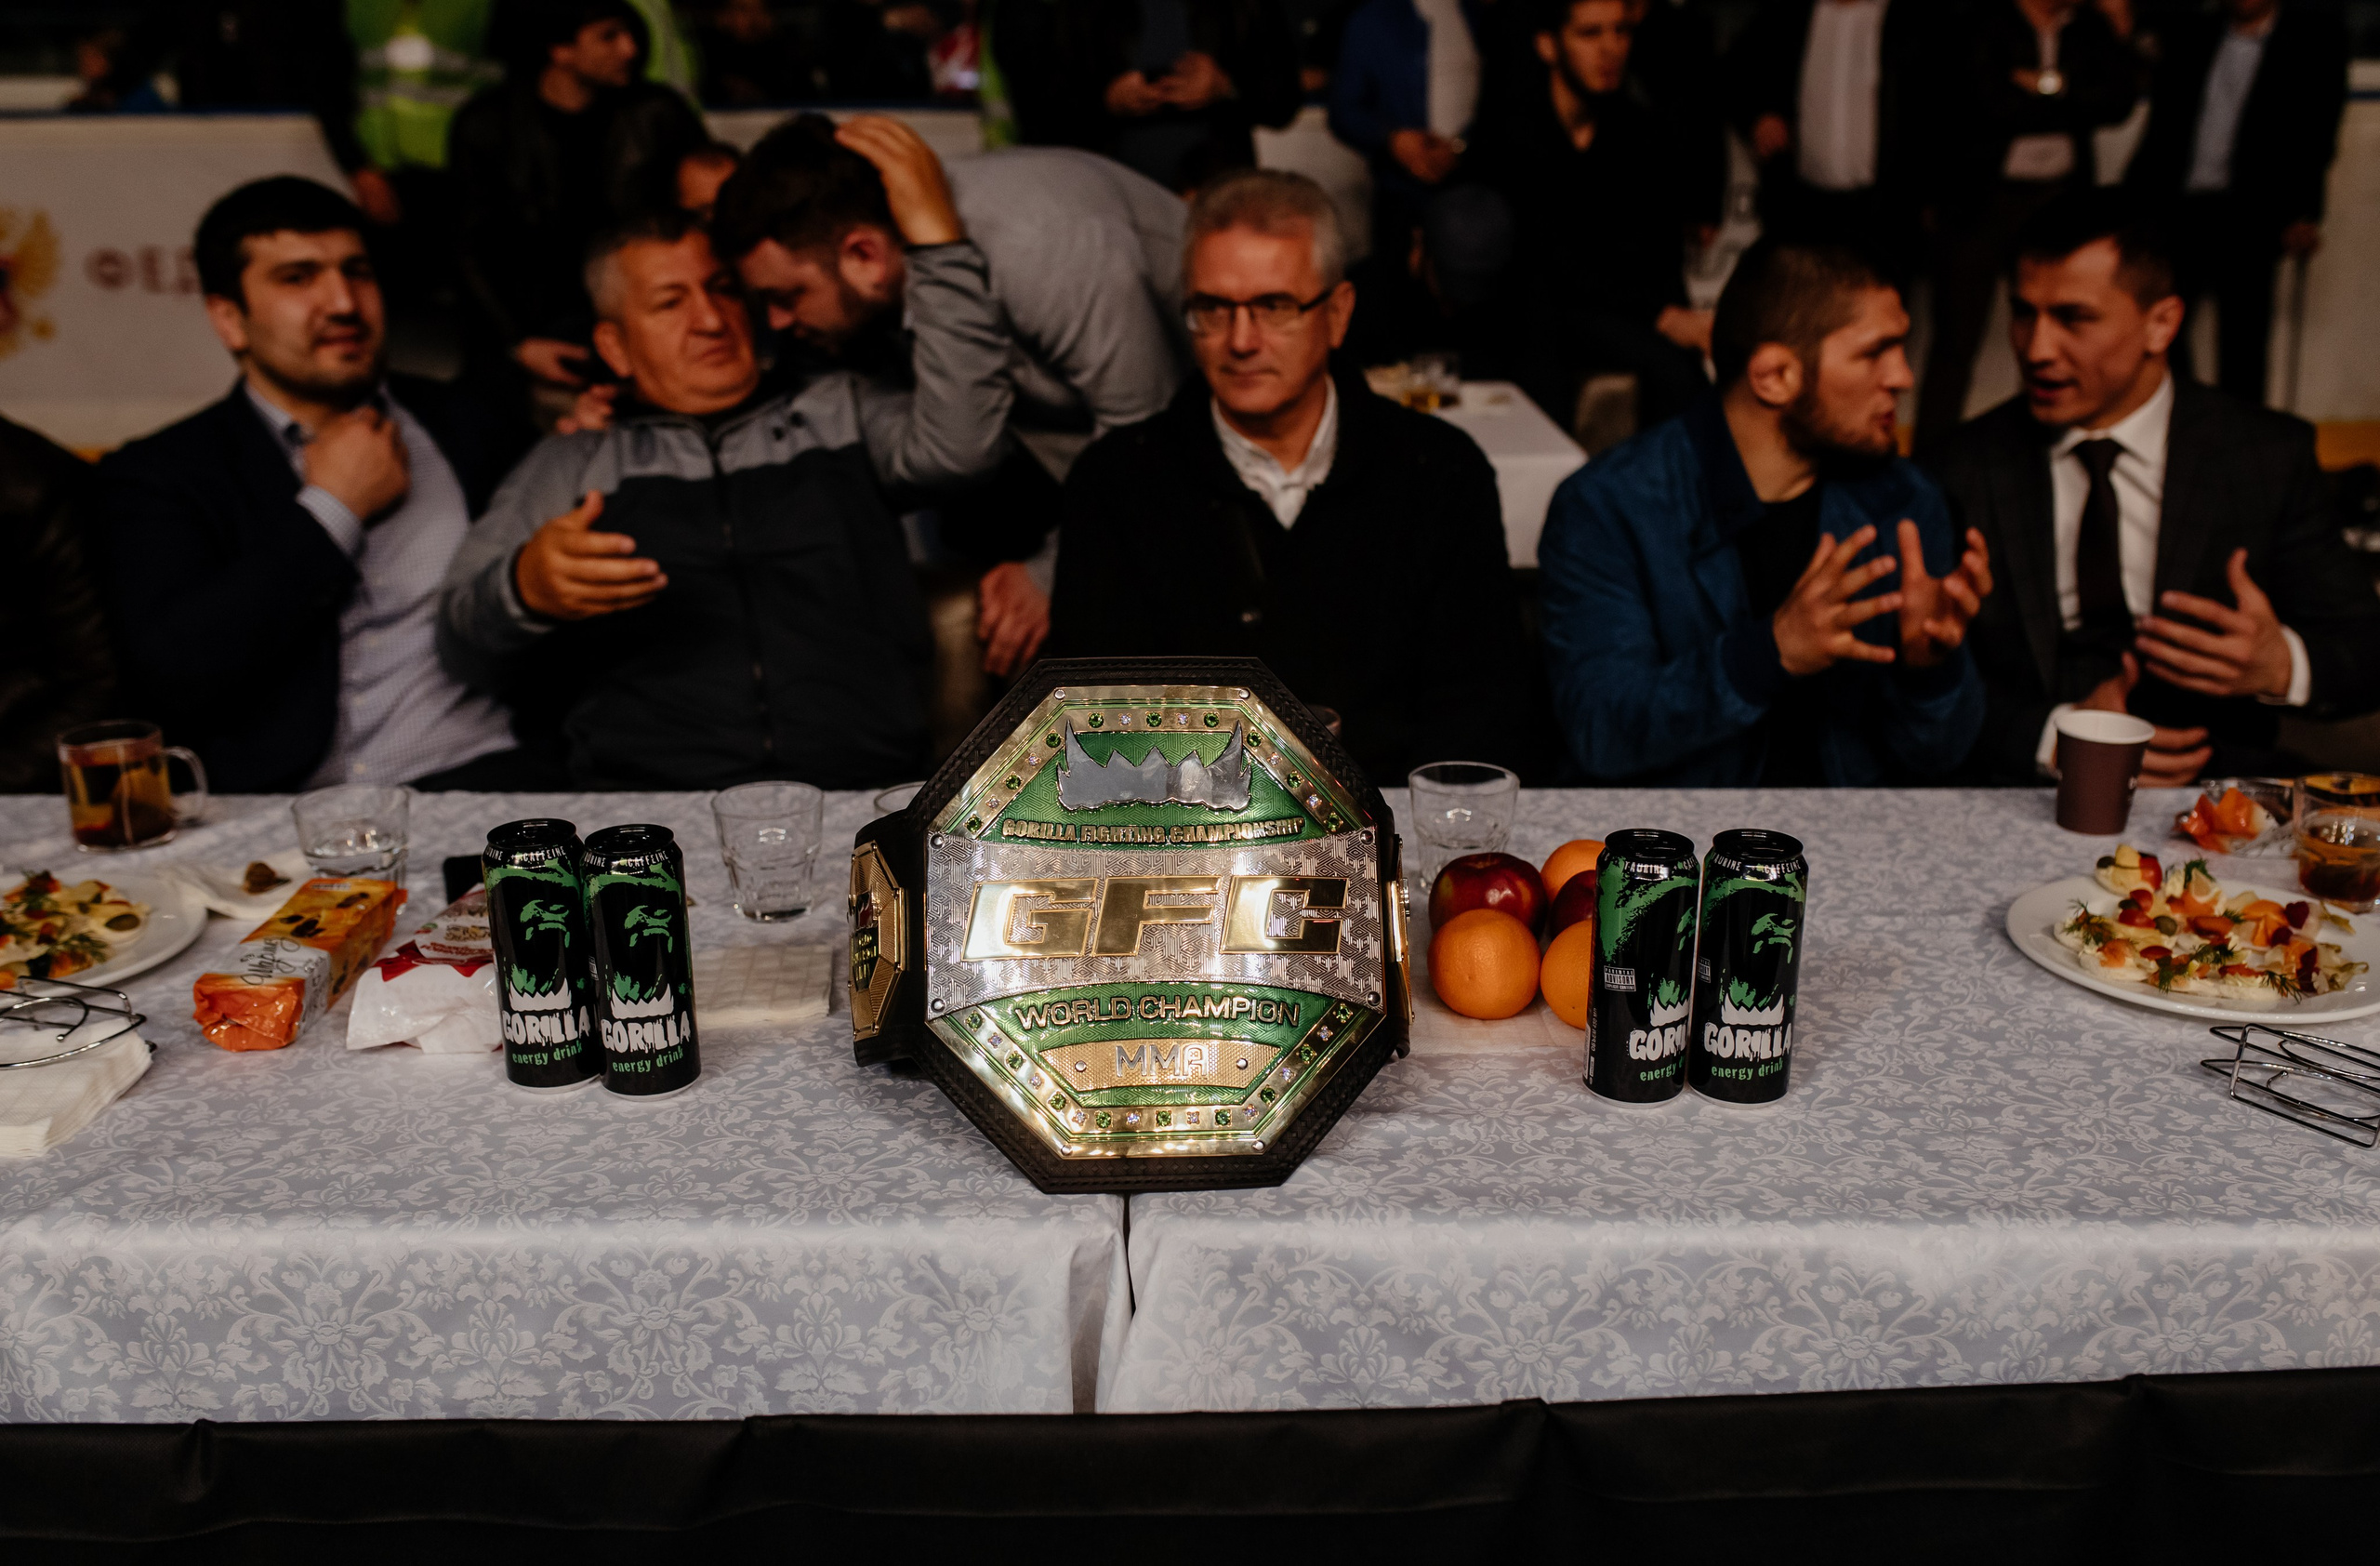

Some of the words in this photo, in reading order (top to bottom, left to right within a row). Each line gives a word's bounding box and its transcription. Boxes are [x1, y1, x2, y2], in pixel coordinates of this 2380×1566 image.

[1001, 818, 1077, 841] GORILLA
[1079, 825, 1166, 843] FIGHTING
[1169, 816, 1304, 843] CHAMPIONSHIP
[522, 845, 566, 862] CAFFEINE
[628, 850, 669, 867] CAFFEINE
[1712, 852, 1741, 871] TAURINE
[1764, 859, 1802, 875] CAFFEINE
[1624, 860, 1665, 874] TAURINE
[960, 875, 1350, 962] GFC
[1606, 973, 1634, 985] ADVISORY
[1015, 996, 1132, 1030] WORLD
[1139, 995, 1301, 1027] CHAMPION
[502, 1005, 591, 1047] GORILLA
[601, 1011, 692, 1054] GORILLA
[512, 1052, 549, 1066] energy
[553, 1040, 583, 1061] drink
[1704, 1022, 1792, 1061] GORILLA
[613, 1058, 652, 1073] energy
[656, 1045, 684, 1068] drink
[1116, 1043, 1209, 1078] MMA
[1712, 1065, 1753, 1081] energy
[1758, 1057, 1783, 1077] drink
[1639, 1063, 1676, 1082] energy
